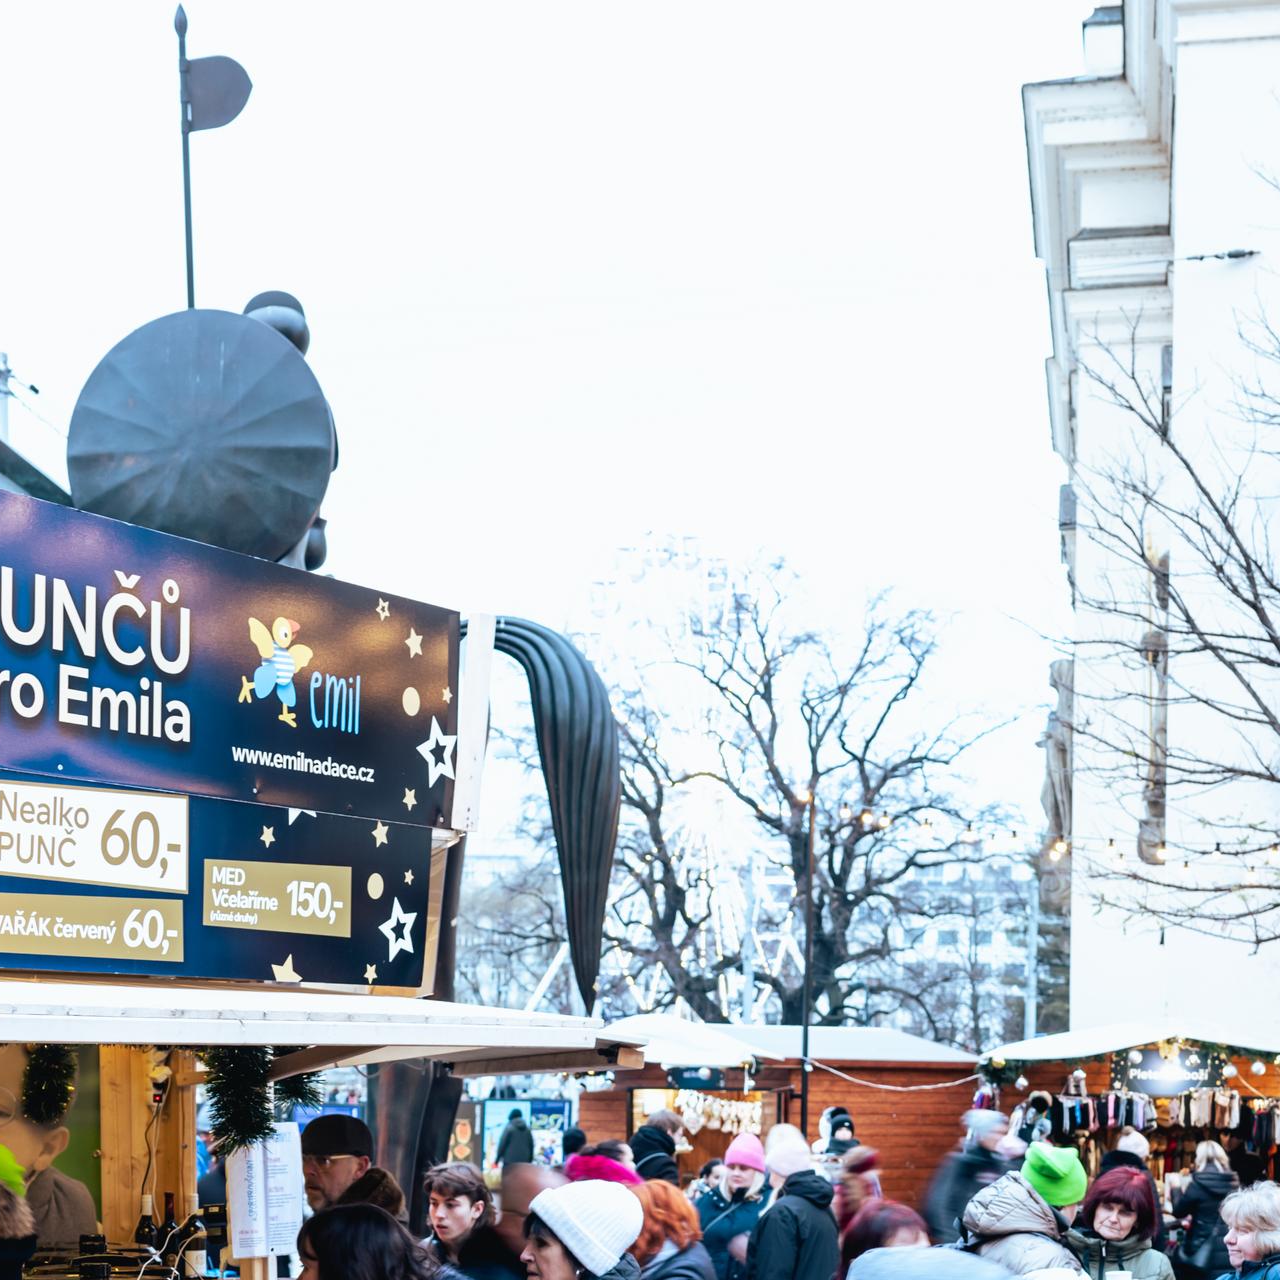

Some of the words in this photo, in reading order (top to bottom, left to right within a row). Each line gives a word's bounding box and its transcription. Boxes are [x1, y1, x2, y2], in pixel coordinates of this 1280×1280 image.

[58, 664, 191, 743] Emila
[310, 671, 361, 735] emil
[231, 746, 375, 783] www.emilnadace.cz
[101, 810, 181, 878] 60,-
[212, 866, 245, 886] MED
[212, 888, 278, 911] Včelaříme
[286, 880, 343, 925] 150,-
[53, 917, 116, 945] červený
[123, 909, 178, 955] 60,-
